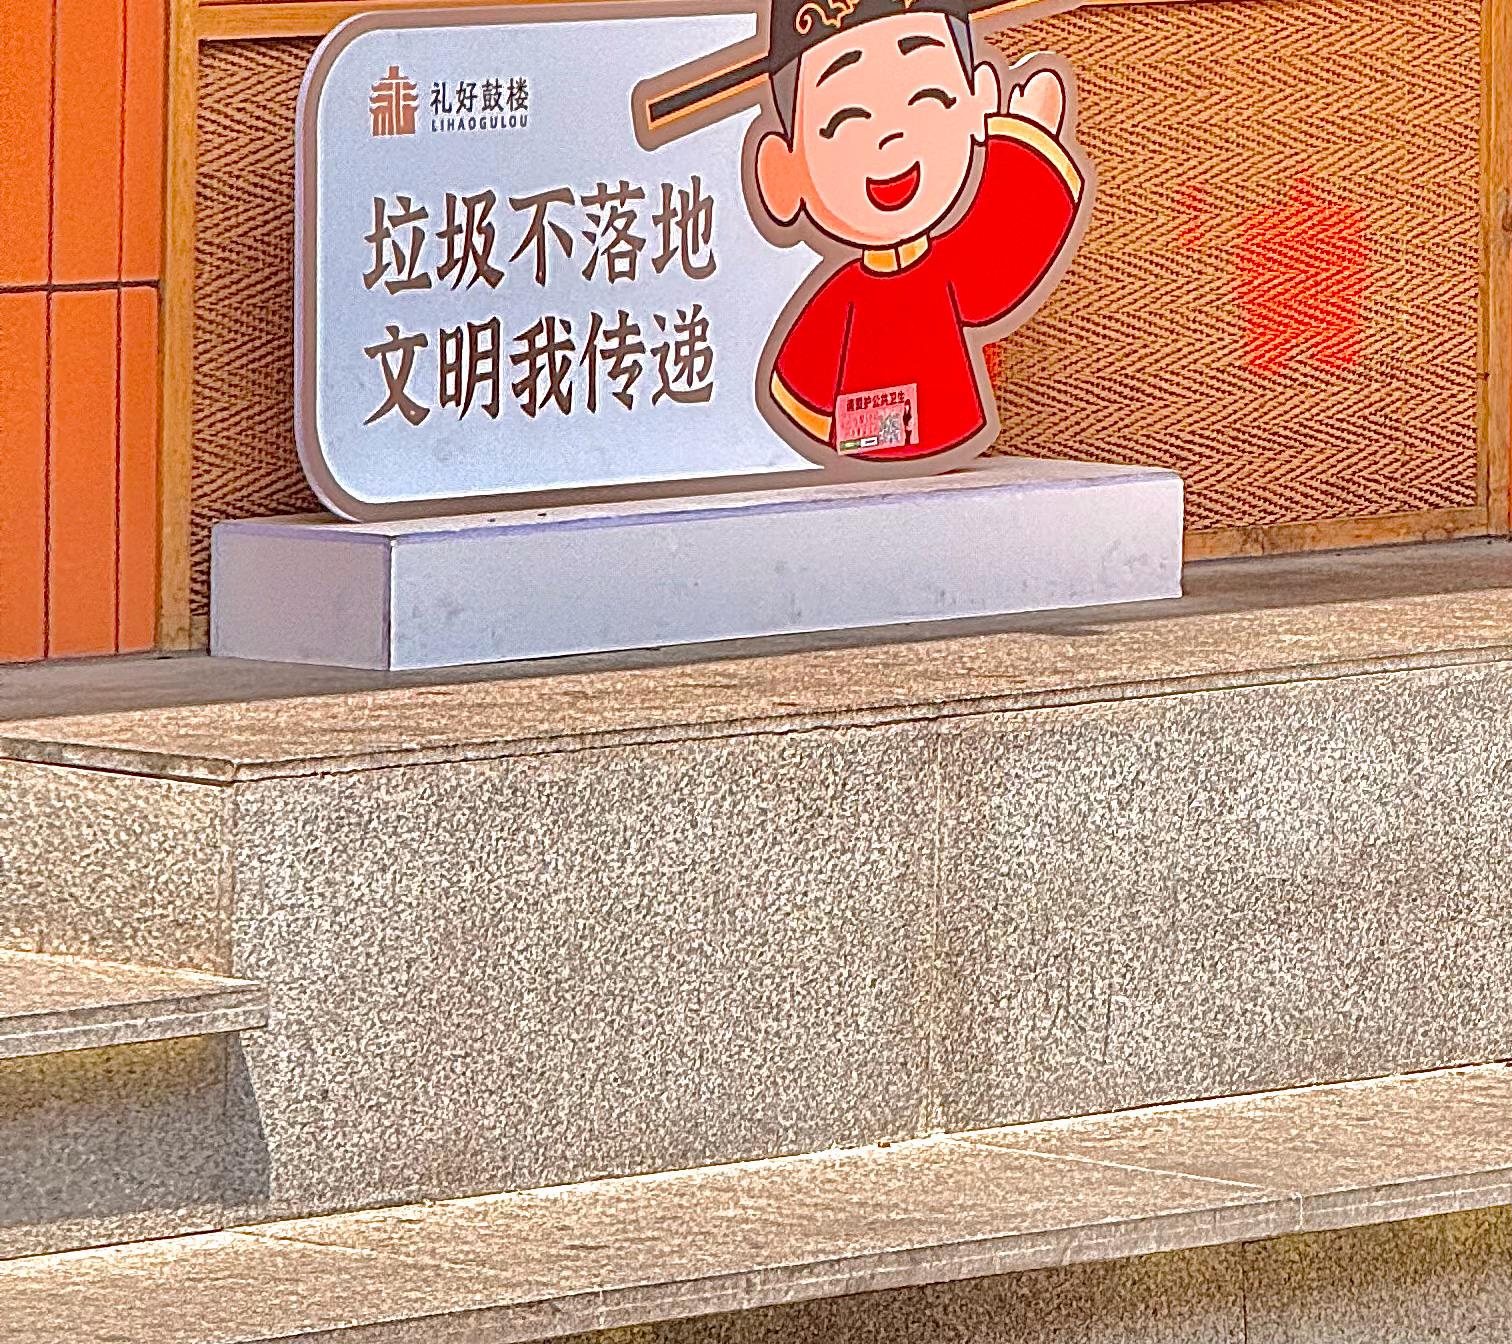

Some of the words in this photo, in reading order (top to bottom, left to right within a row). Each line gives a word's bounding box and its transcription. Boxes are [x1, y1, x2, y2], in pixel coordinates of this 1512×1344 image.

[430, 77, 529, 115] 礼好鼓楼
[431, 115, 529, 133] LIHAOGULOU
[363, 176, 717, 296] 垃圾不落地
[364, 306, 714, 426] 文明我传递
